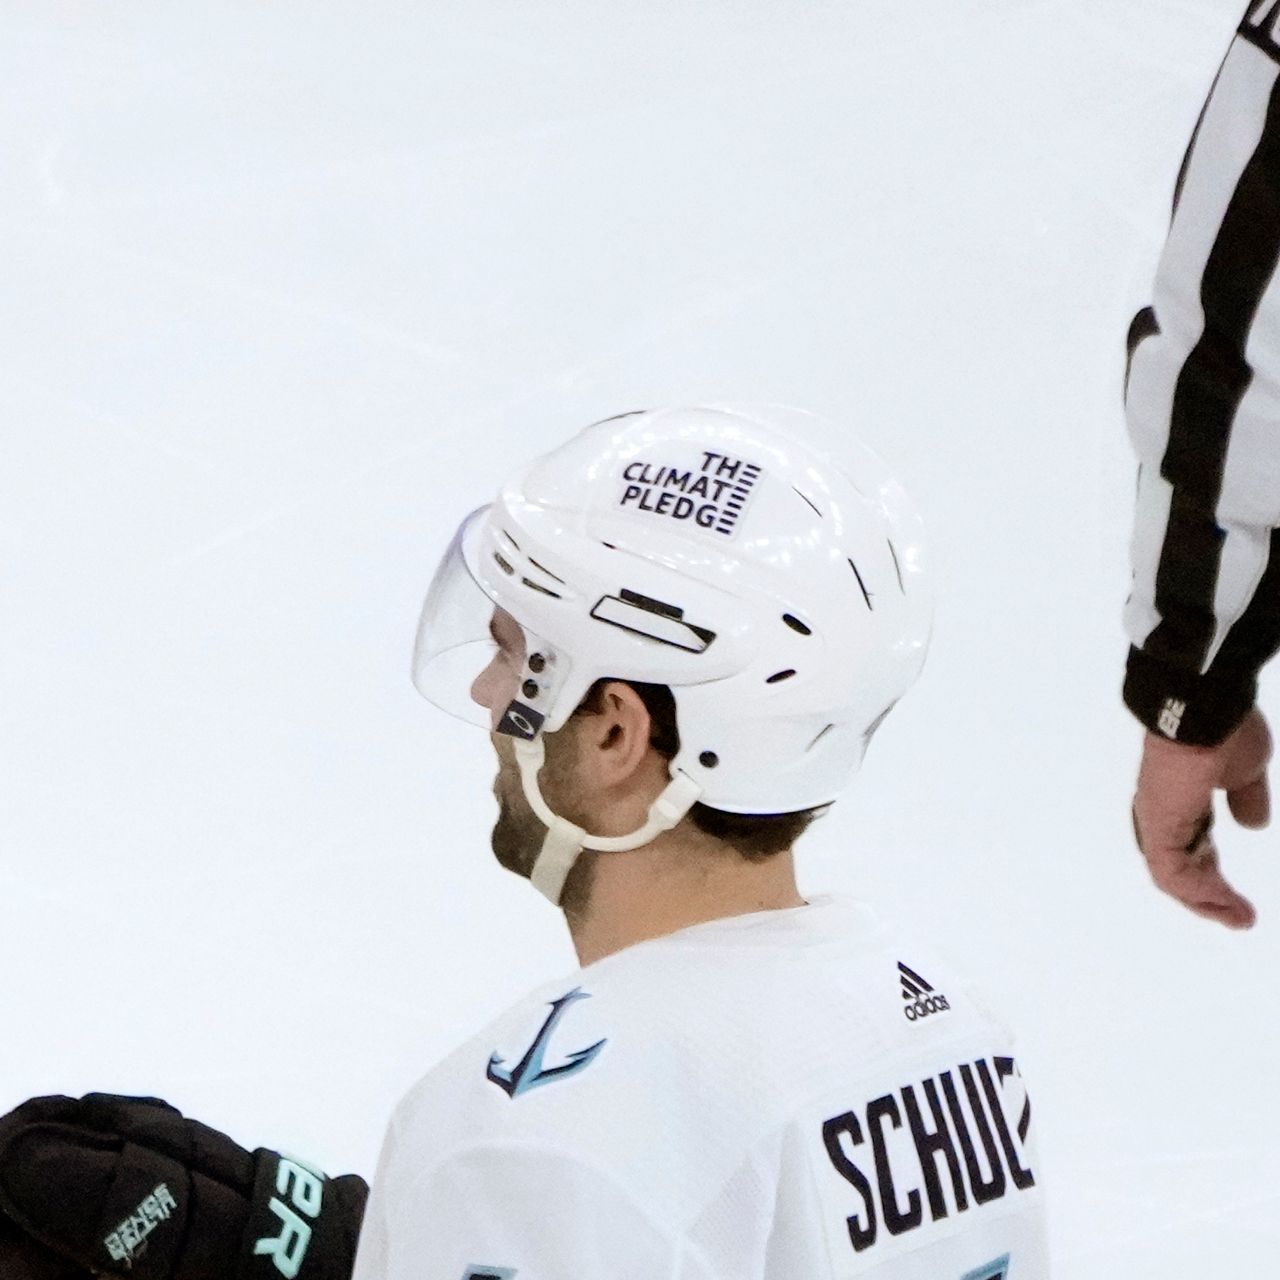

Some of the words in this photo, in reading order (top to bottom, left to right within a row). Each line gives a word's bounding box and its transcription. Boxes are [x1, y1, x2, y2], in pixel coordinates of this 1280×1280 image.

[623, 462, 750, 508] CLIMATE
[703, 451, 762, 485] THE
[620, 485, 739, 535] PLEDGE
